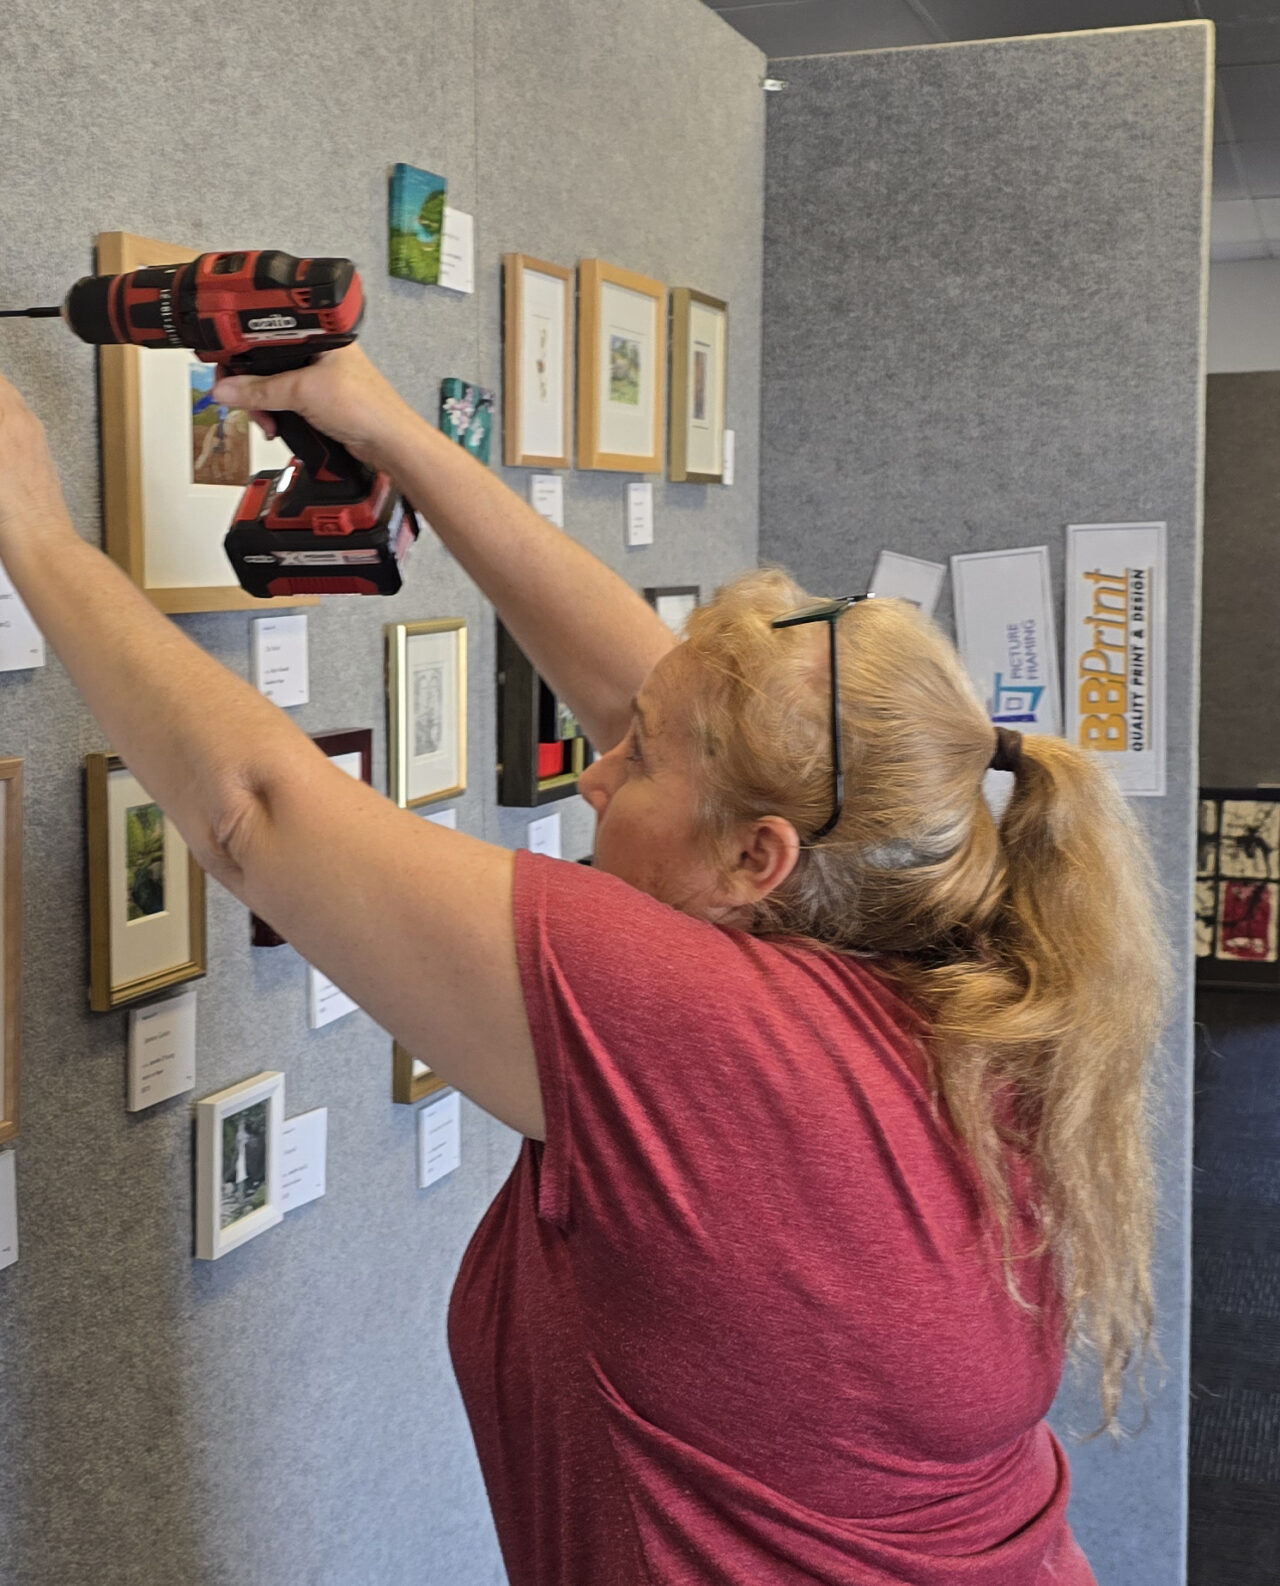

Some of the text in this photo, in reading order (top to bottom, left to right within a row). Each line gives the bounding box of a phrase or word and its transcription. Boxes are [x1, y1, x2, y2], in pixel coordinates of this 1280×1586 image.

[1131, 568, 1145, 622] DESIGN
[1006, 623, 1023, 680] PICTURE
[1021, 619, 1040, 681] FRAMING
[1078, 568, 1128, 752] BBPrint
[1131, 643, 1145, 687] PRINT
[1131, 693, 1145, 752] QUALITY
